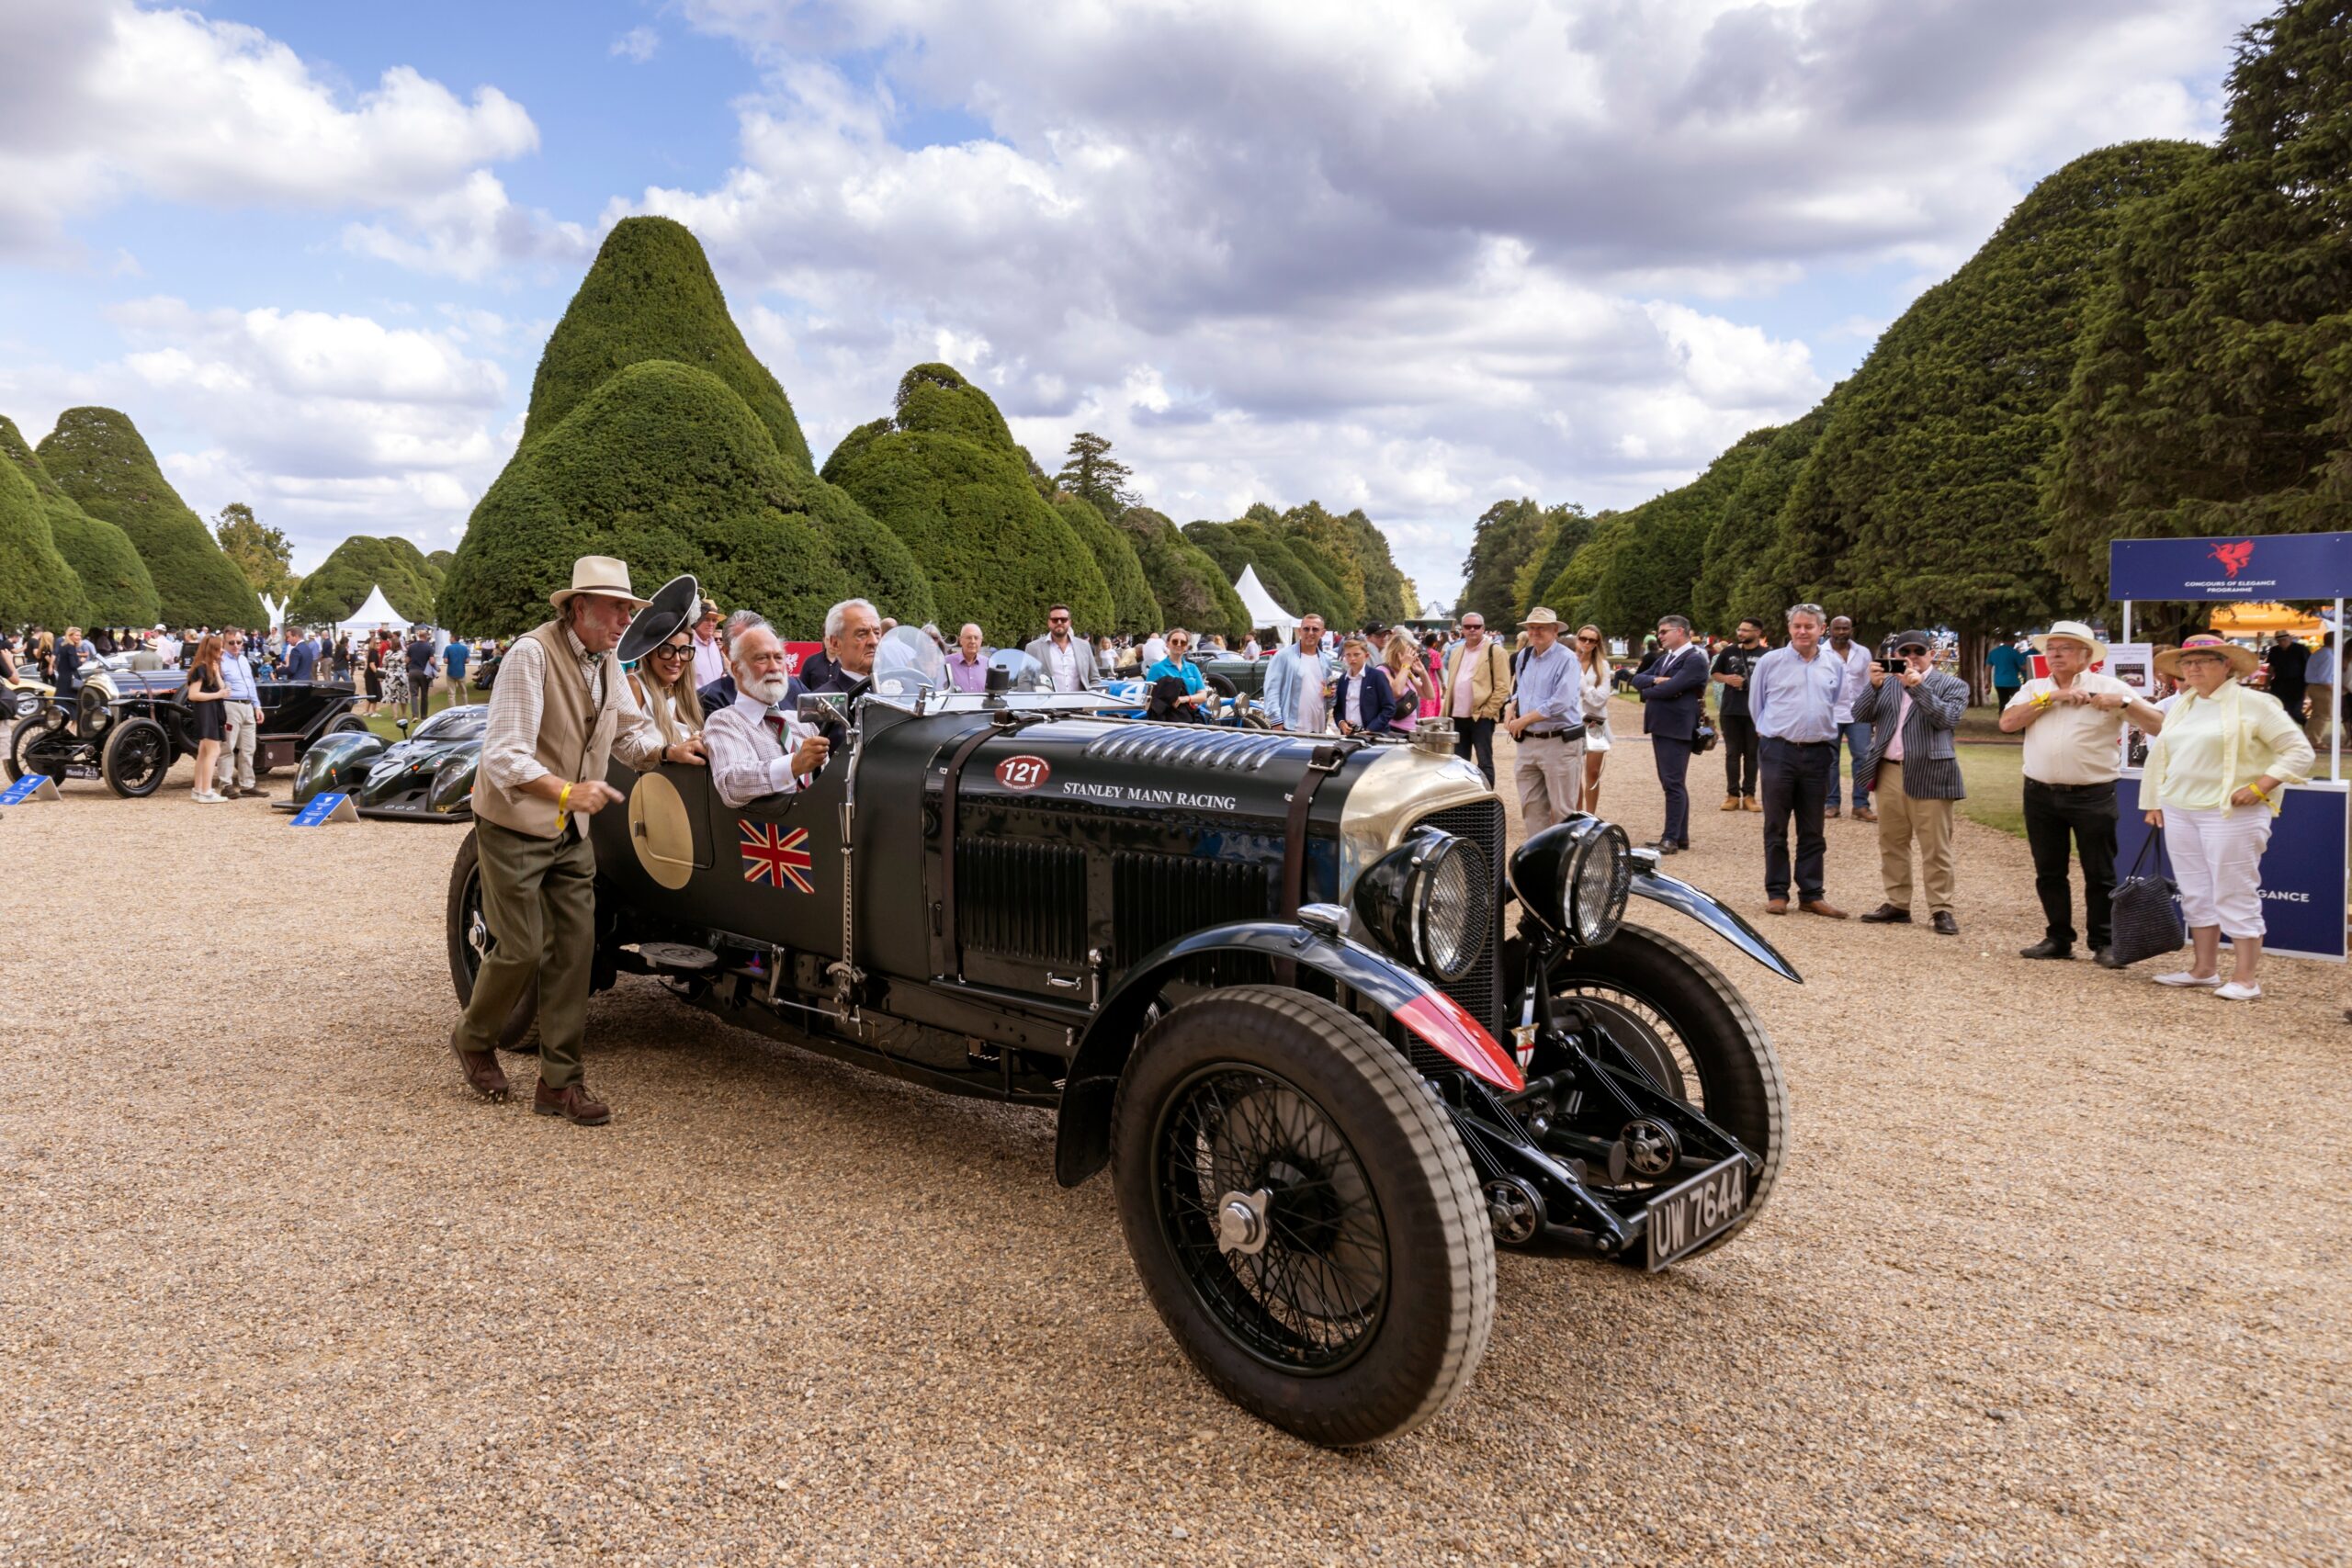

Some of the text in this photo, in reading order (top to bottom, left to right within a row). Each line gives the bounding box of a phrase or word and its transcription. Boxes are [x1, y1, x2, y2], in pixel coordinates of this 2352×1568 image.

[373, 761, 403, 775] 7
[1005, 761, 1041, 783] 121
[1063, 782, 1236, 810] STANLEY MANN RACING
[2256, 888, 2310, 903] GANCE
[1656, 1166, 1743, 1258] UW 7644
